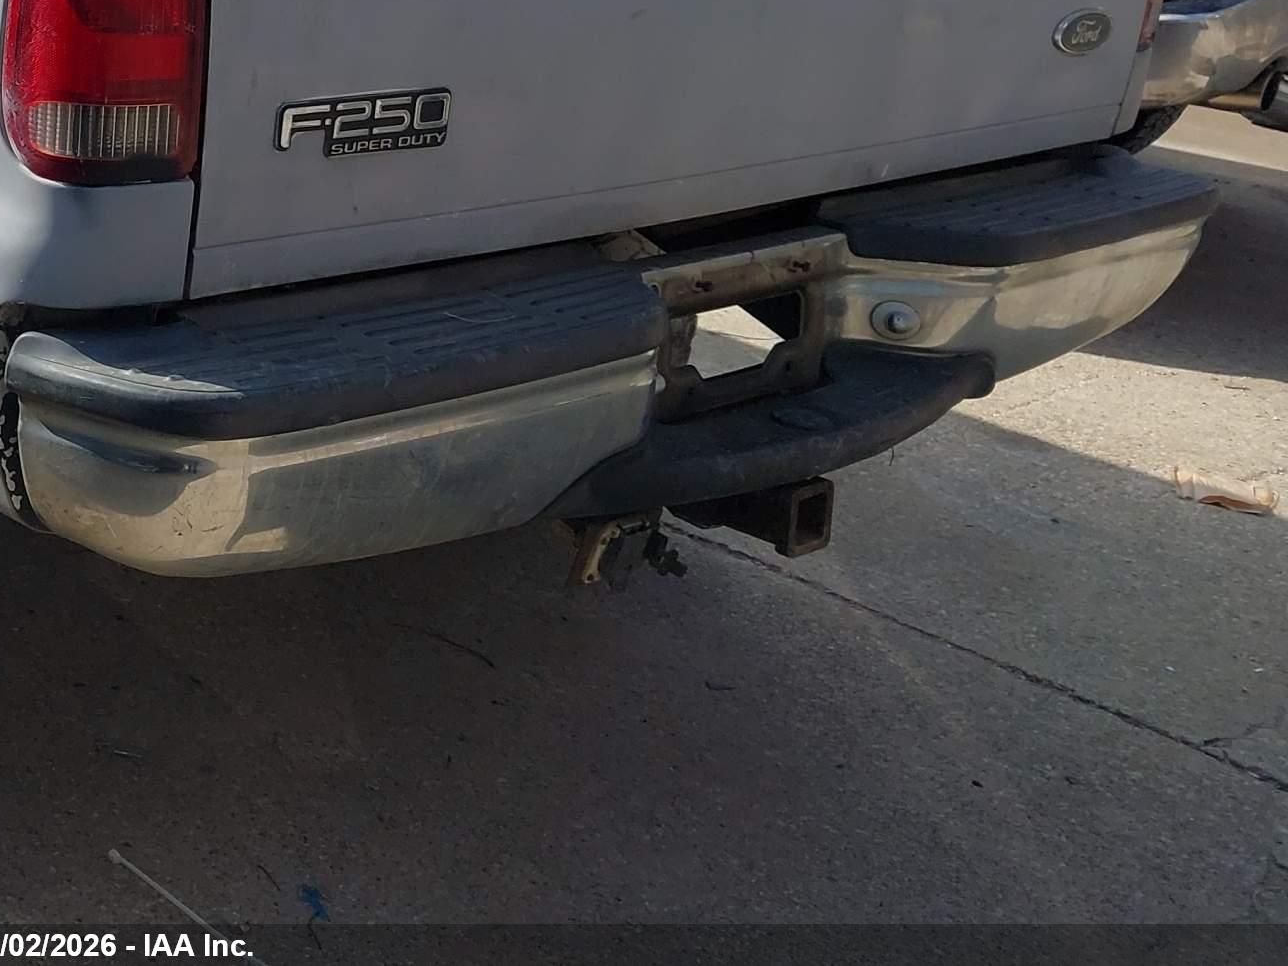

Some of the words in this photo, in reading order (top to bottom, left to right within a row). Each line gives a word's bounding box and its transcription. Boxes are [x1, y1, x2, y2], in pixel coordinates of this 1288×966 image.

[280, 91, 452, 149] F-250
[330, 137, 393, 156] SUPER
[397, 131, 448, 148] DUTY
